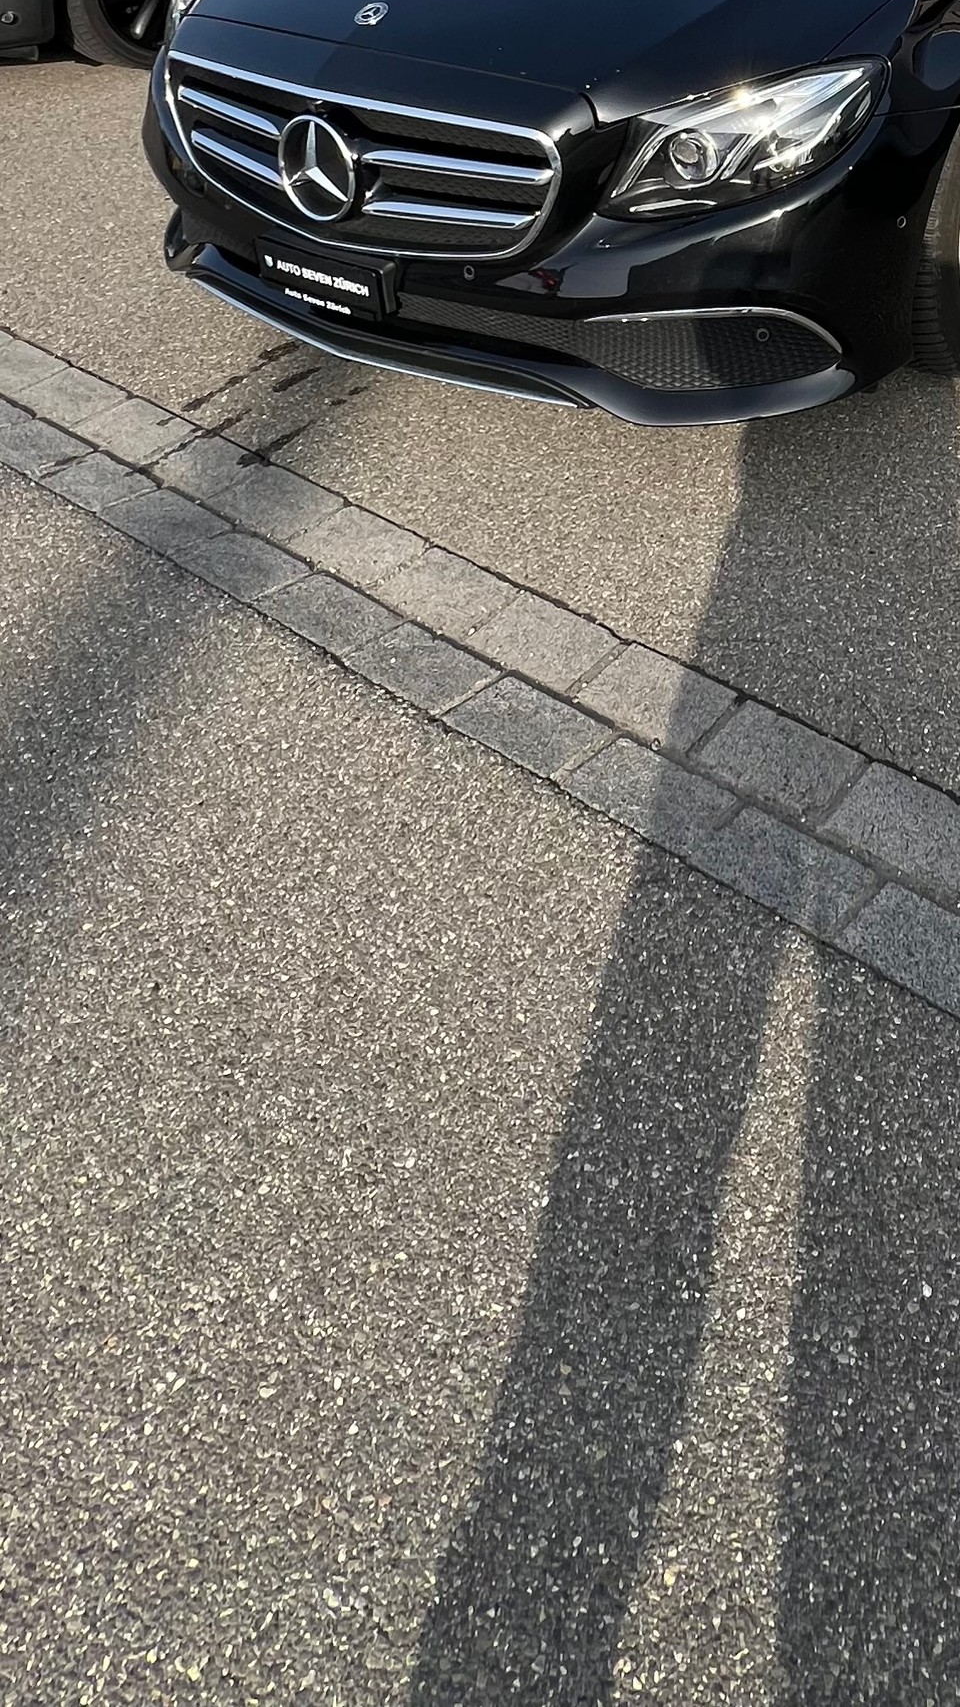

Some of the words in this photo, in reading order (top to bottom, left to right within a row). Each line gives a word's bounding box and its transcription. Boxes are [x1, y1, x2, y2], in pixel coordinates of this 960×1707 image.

[276, 259, 301, 277] AUTO
[301, 267, 332, 286] SEVEN
[332, 277, 370, 297] ZÜRICH
